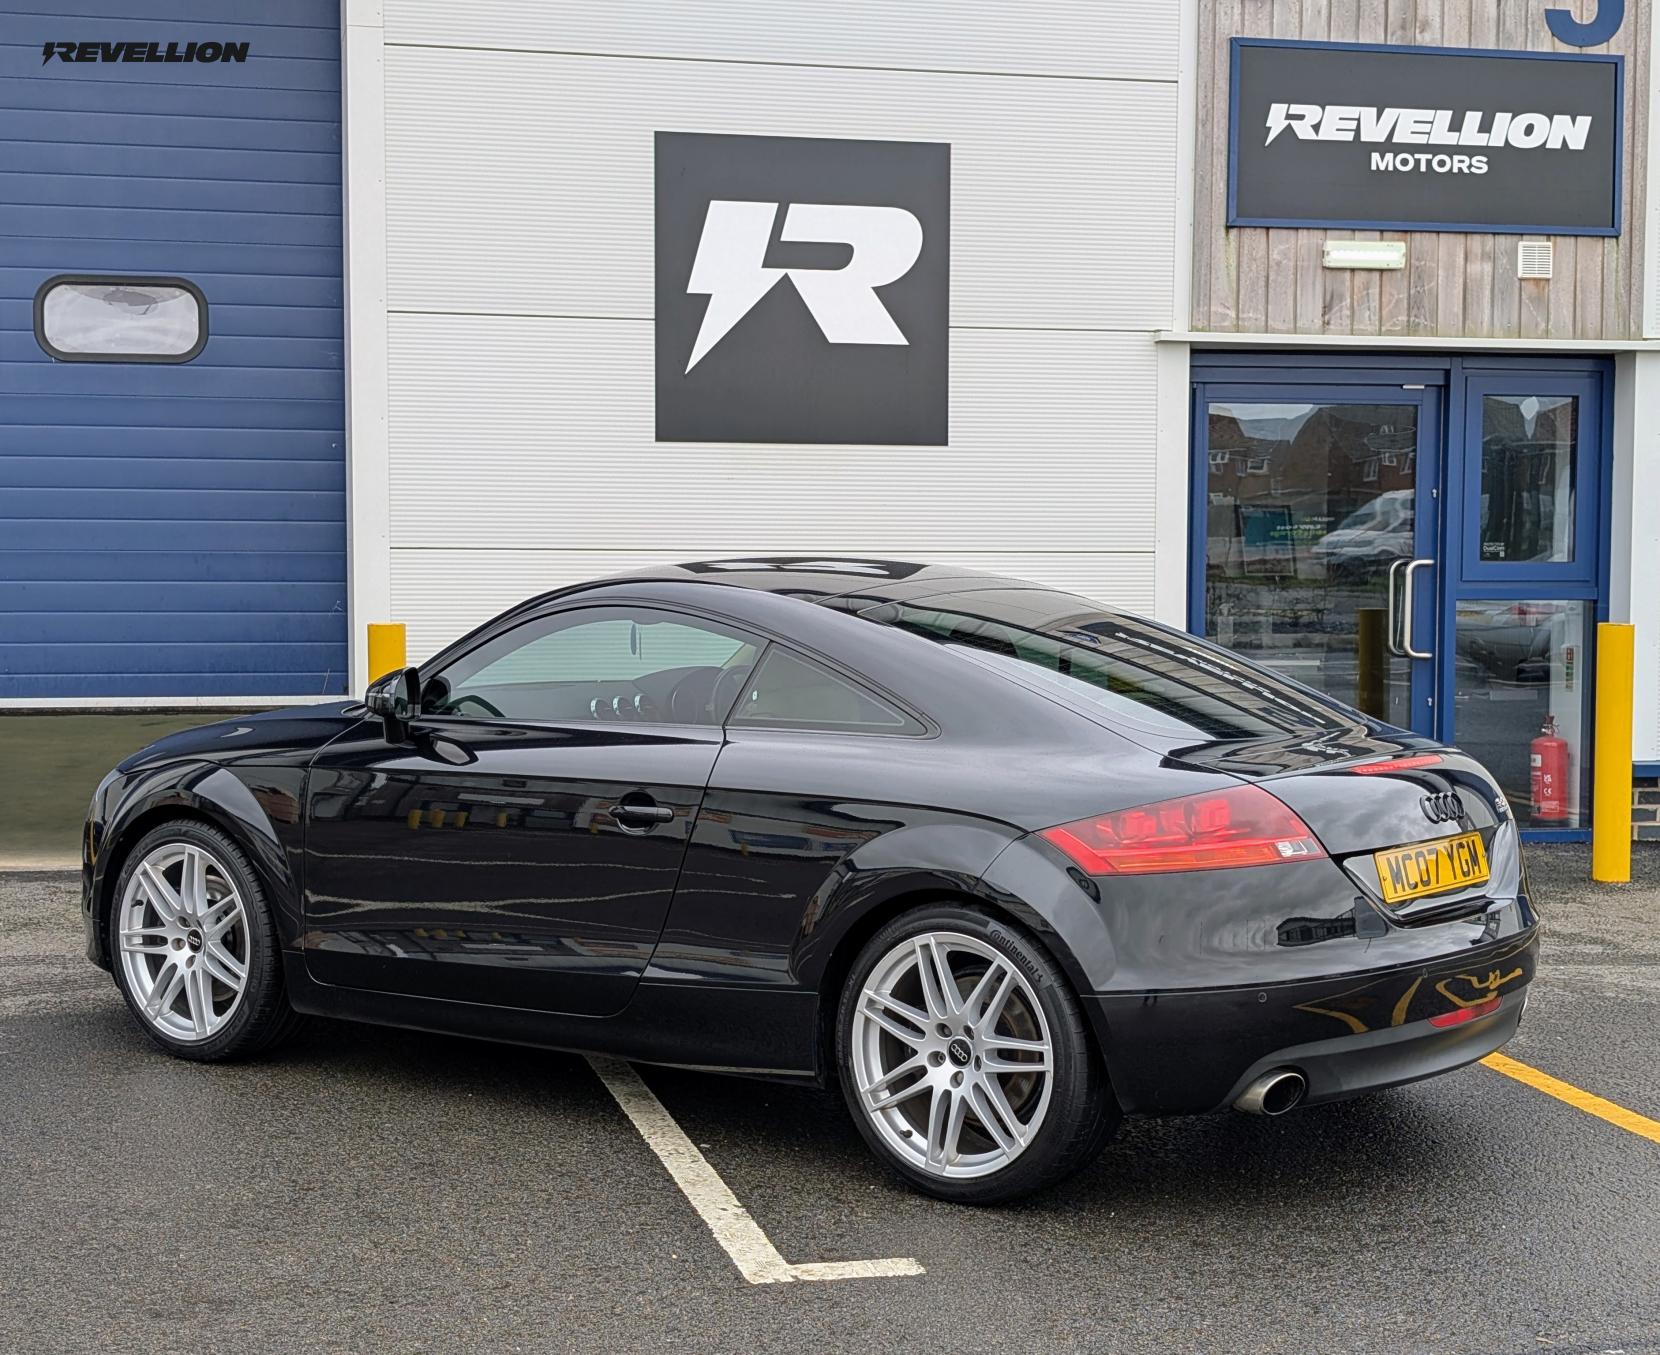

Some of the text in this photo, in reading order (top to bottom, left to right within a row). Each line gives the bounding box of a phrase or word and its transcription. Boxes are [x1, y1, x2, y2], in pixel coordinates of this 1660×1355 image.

[1264, 103, 1593, 150] REVELLION
[1370, 152, 1489, 174] MOTORS
[684, 199, 924, 375] R
[1386, 839, 1482, 894] MC07 YGM
[990, 929, 1040, 977] Continental
